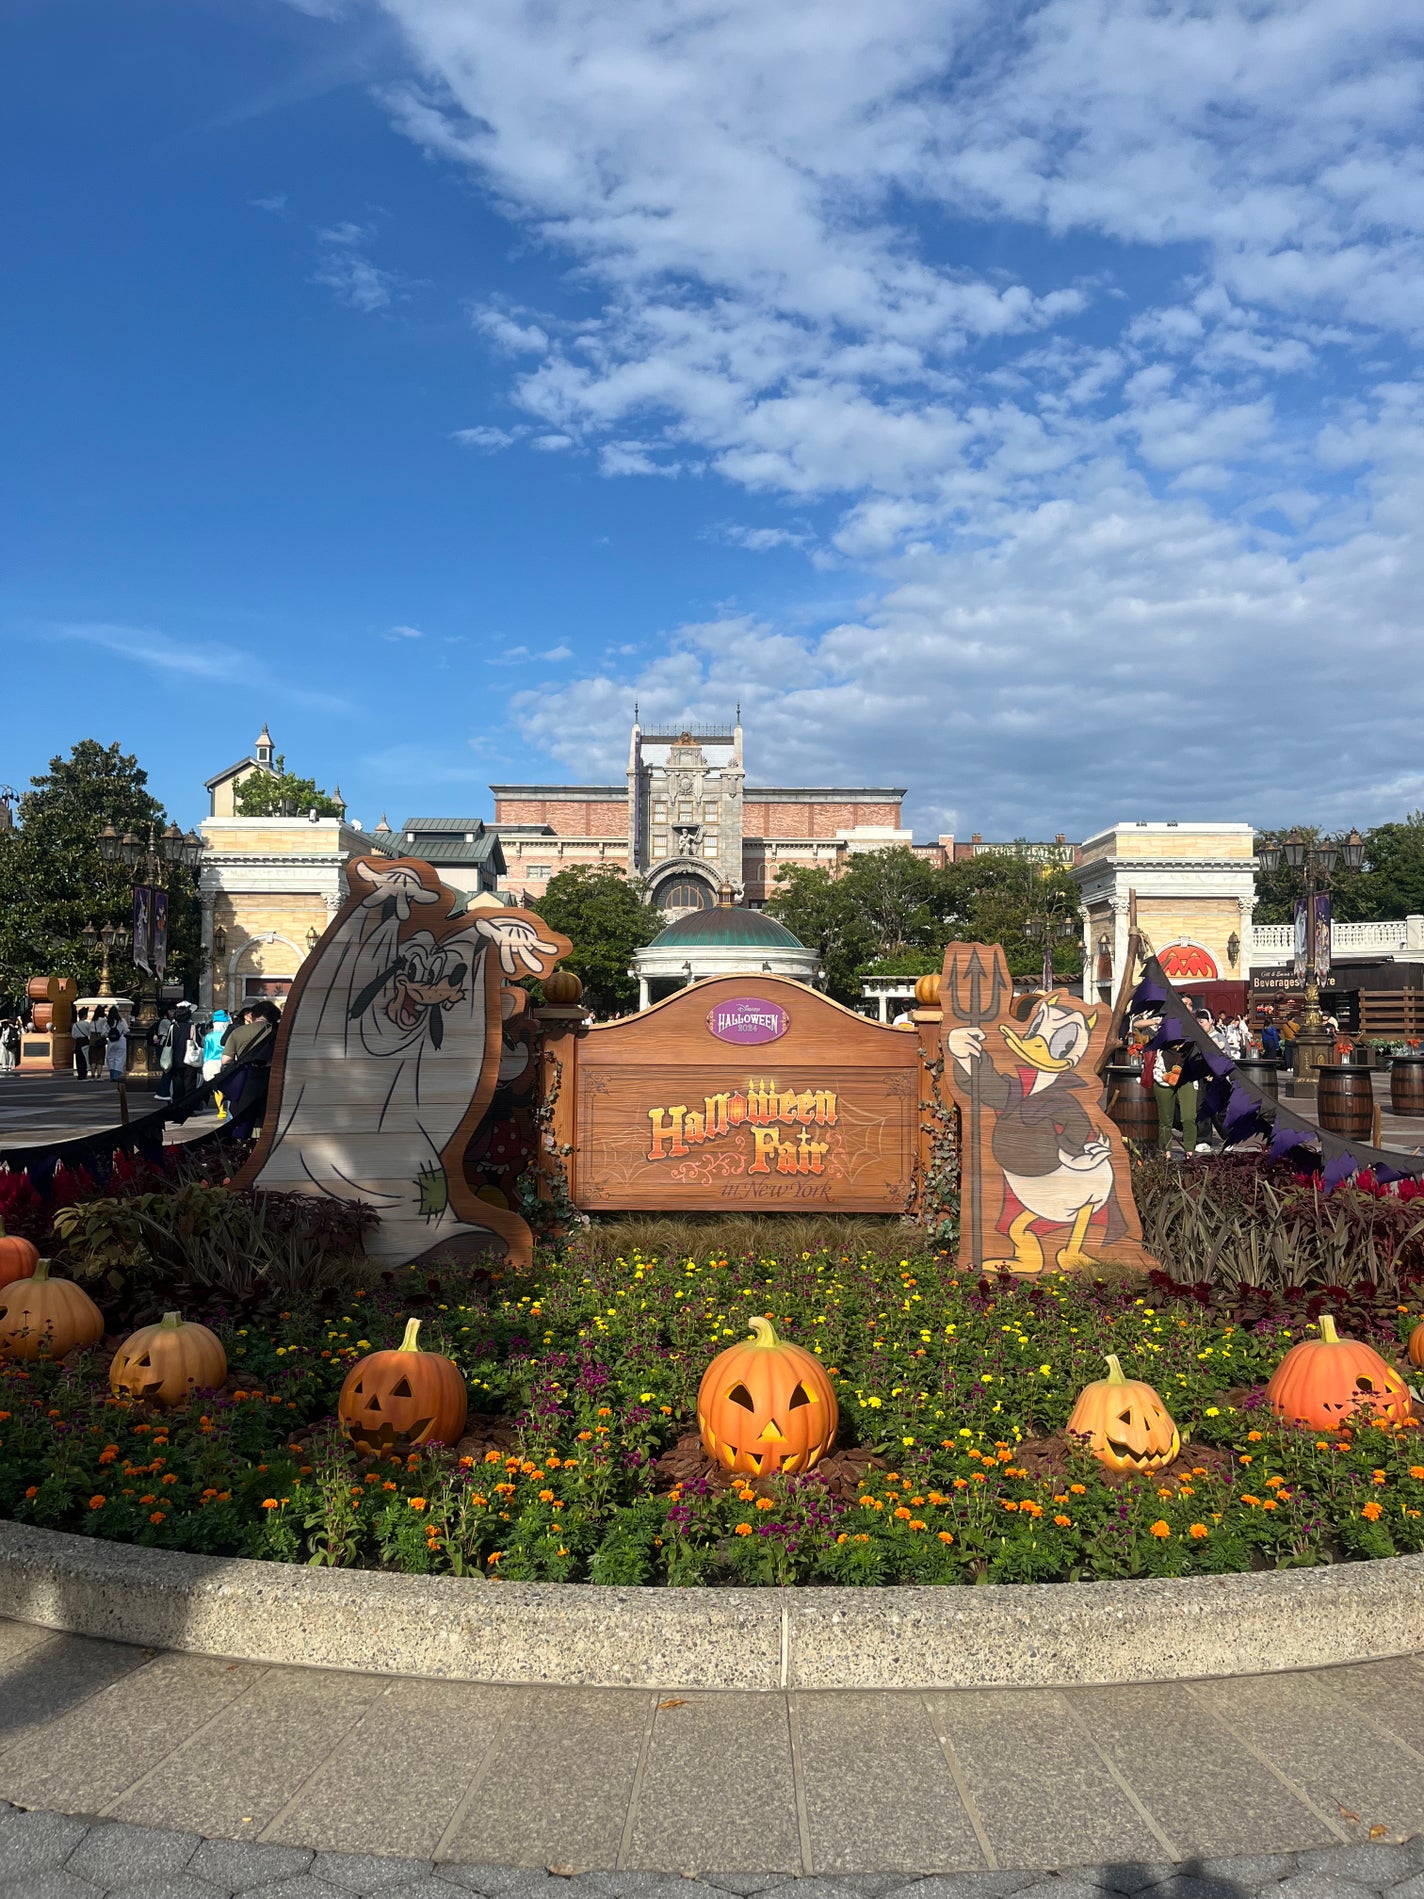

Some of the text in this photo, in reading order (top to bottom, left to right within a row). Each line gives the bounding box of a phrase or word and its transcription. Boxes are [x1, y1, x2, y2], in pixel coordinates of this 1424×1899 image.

[1254, 978, 1300, 989] Beverages
[736, 1004, 760, 1013] Disney
[718, 1013, 778, 1034] HALLOWEEN
[737, 1023, 758, 1032] 2024
[647, 1087, 838, 1160] Halloween
[748, 1125, 830, 1175] Fair
[721, 1177, 836, 1203] in New York
